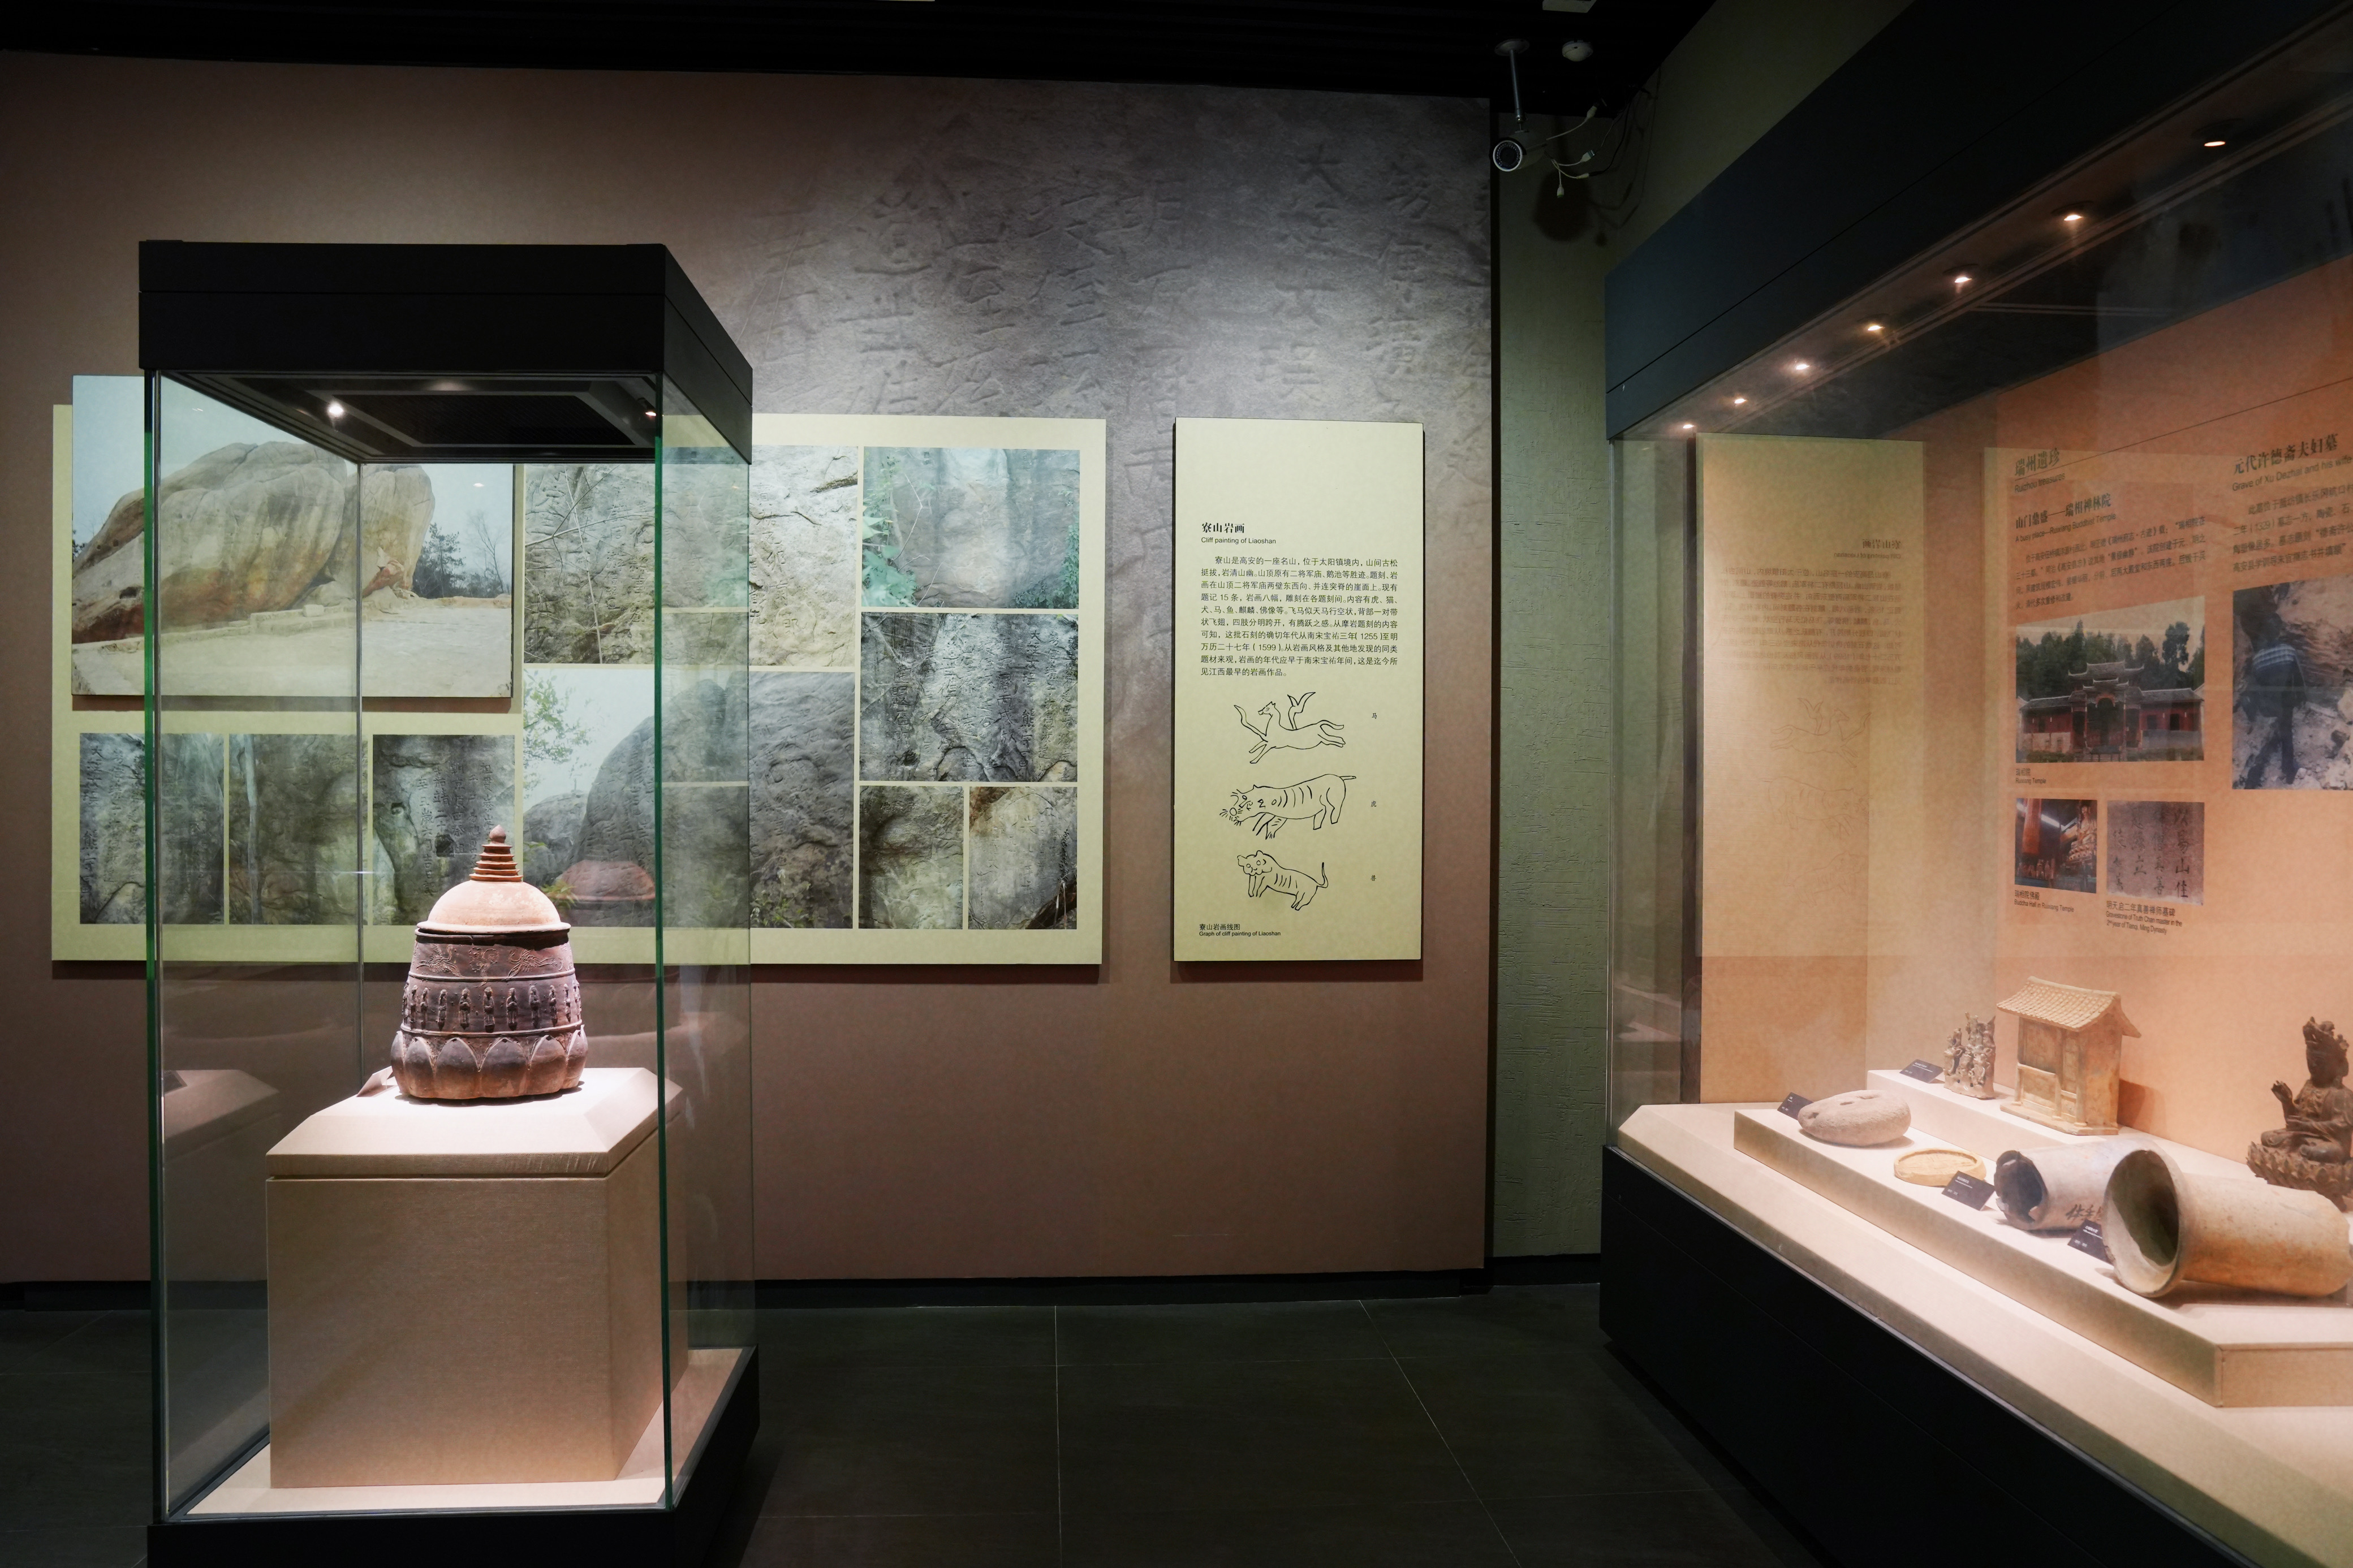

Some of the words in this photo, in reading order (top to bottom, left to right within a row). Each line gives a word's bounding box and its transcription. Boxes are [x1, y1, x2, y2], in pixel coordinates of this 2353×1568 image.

[2015, 447, 2060, 476] 瑞州遗珍
[2014, 481, 2037, 493] Ruizhou
[2039, 473, 2066, 486] treasures
[2233, 480, 2254, 491] Grave
[2255, 475, 2262, 486] of
[2264, 475, 2274, 485] Xu
[2304, 464, 2319, 474] and
[2096, 513, 2117, 524] Temple
[1202, 522, 1244, 533] 寮山岩画
[1200, 668, 1287, 677] 见江西最早的岩画作品。
[2140, 924, 2150, 933] Ming
[2151, 925, 2167, 935] Dynasty
